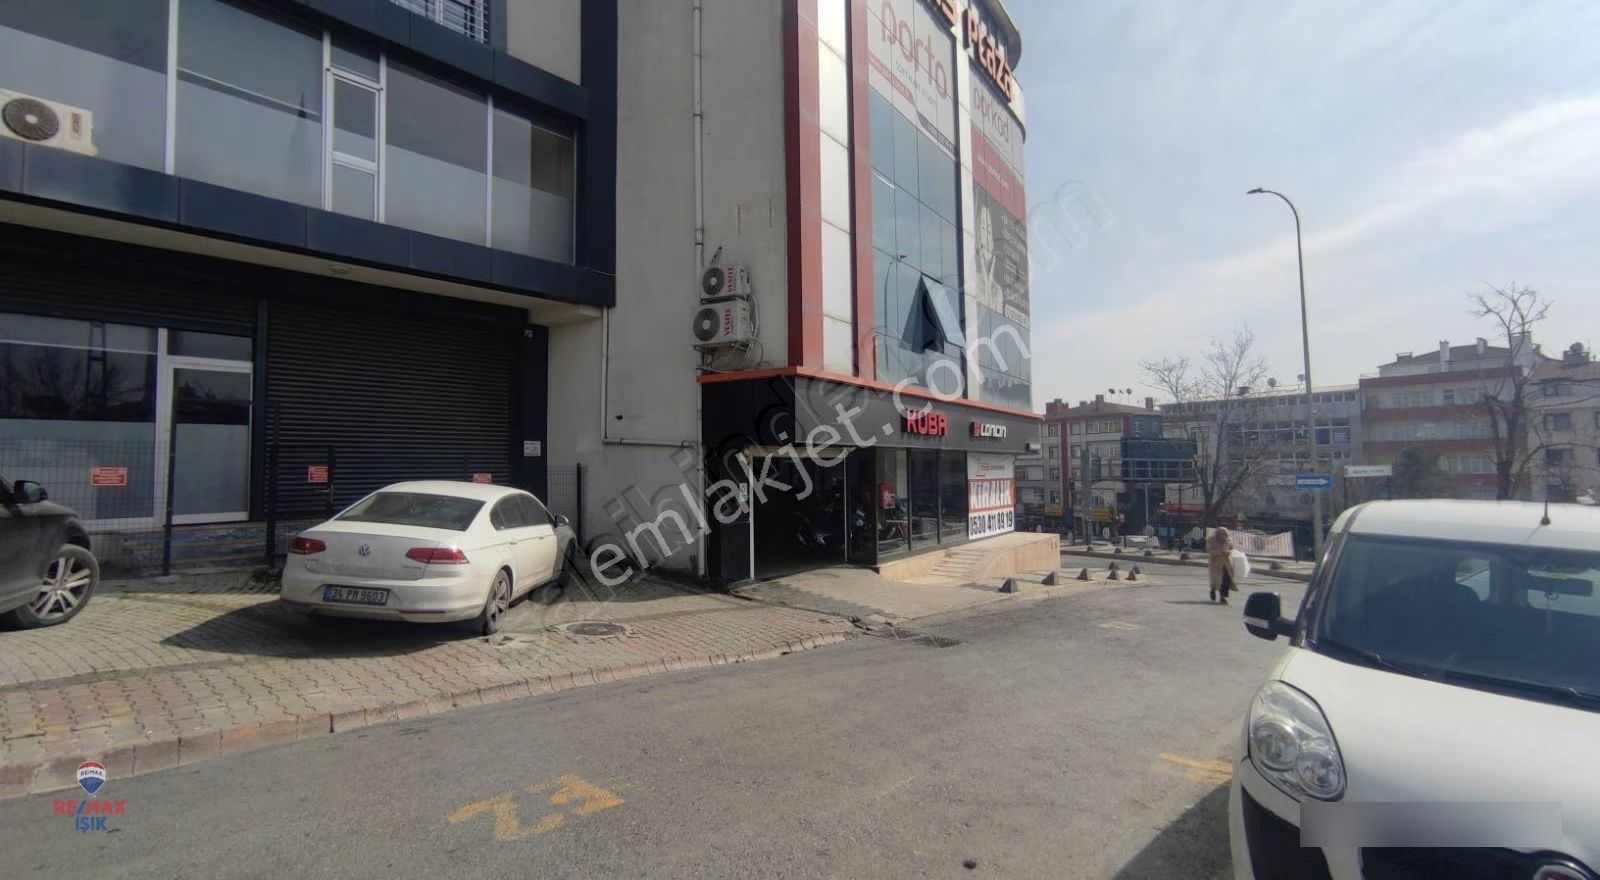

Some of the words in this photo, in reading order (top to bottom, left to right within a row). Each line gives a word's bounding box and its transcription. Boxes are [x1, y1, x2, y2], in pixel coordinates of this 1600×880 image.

[906, 408, 948, 436] KUBA
[1006, 510, 1013, 528] 19
[332, 588, 343, 599] 34
[360, 590, 385, 602] 9603
